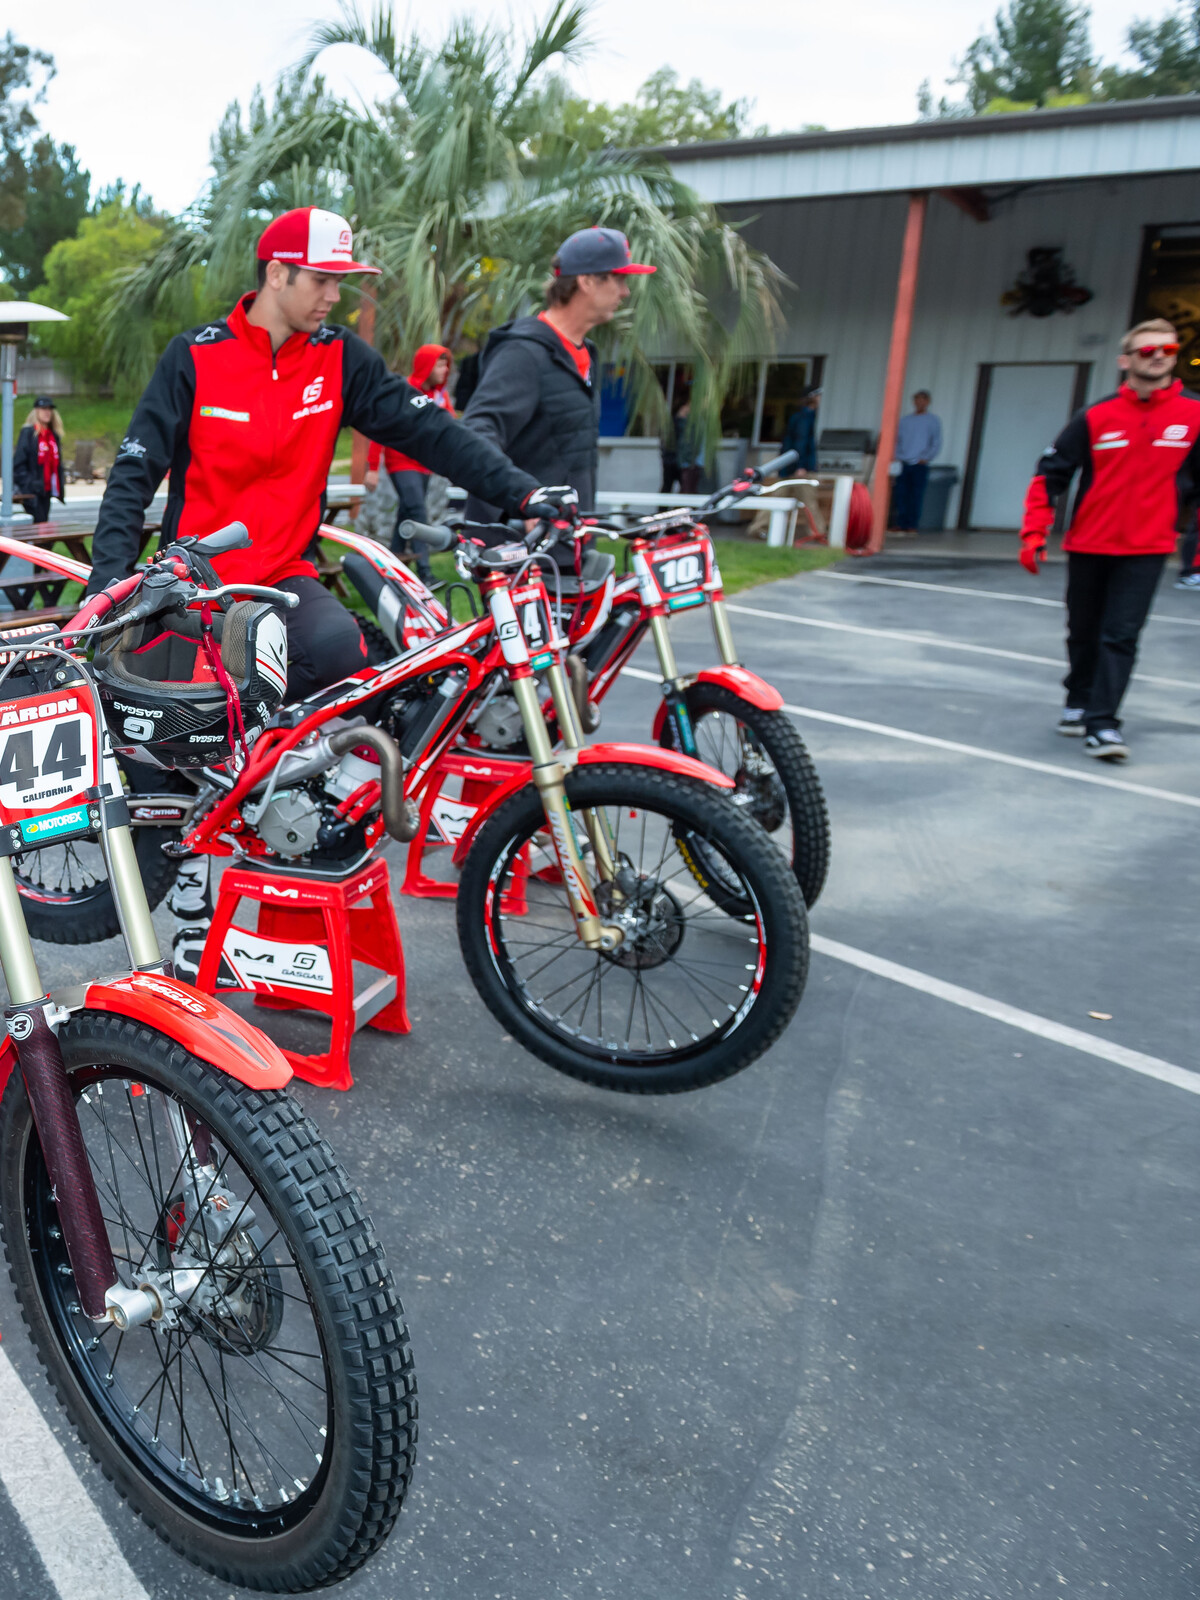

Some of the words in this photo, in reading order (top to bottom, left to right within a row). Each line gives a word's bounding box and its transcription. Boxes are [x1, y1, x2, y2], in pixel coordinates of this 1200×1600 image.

[659, 555, 699, 587] 10
[113, 701, 164, 718] GASGAS
[189, 735, 224, 743] GASGAS
[22, 785, 73, 803] CALIFORNIA
[39, 811, 83, 832] MOTOREX
[281, 968, 324, 981] GASGAS
[131, 979, 207, 1015] GASGAS
